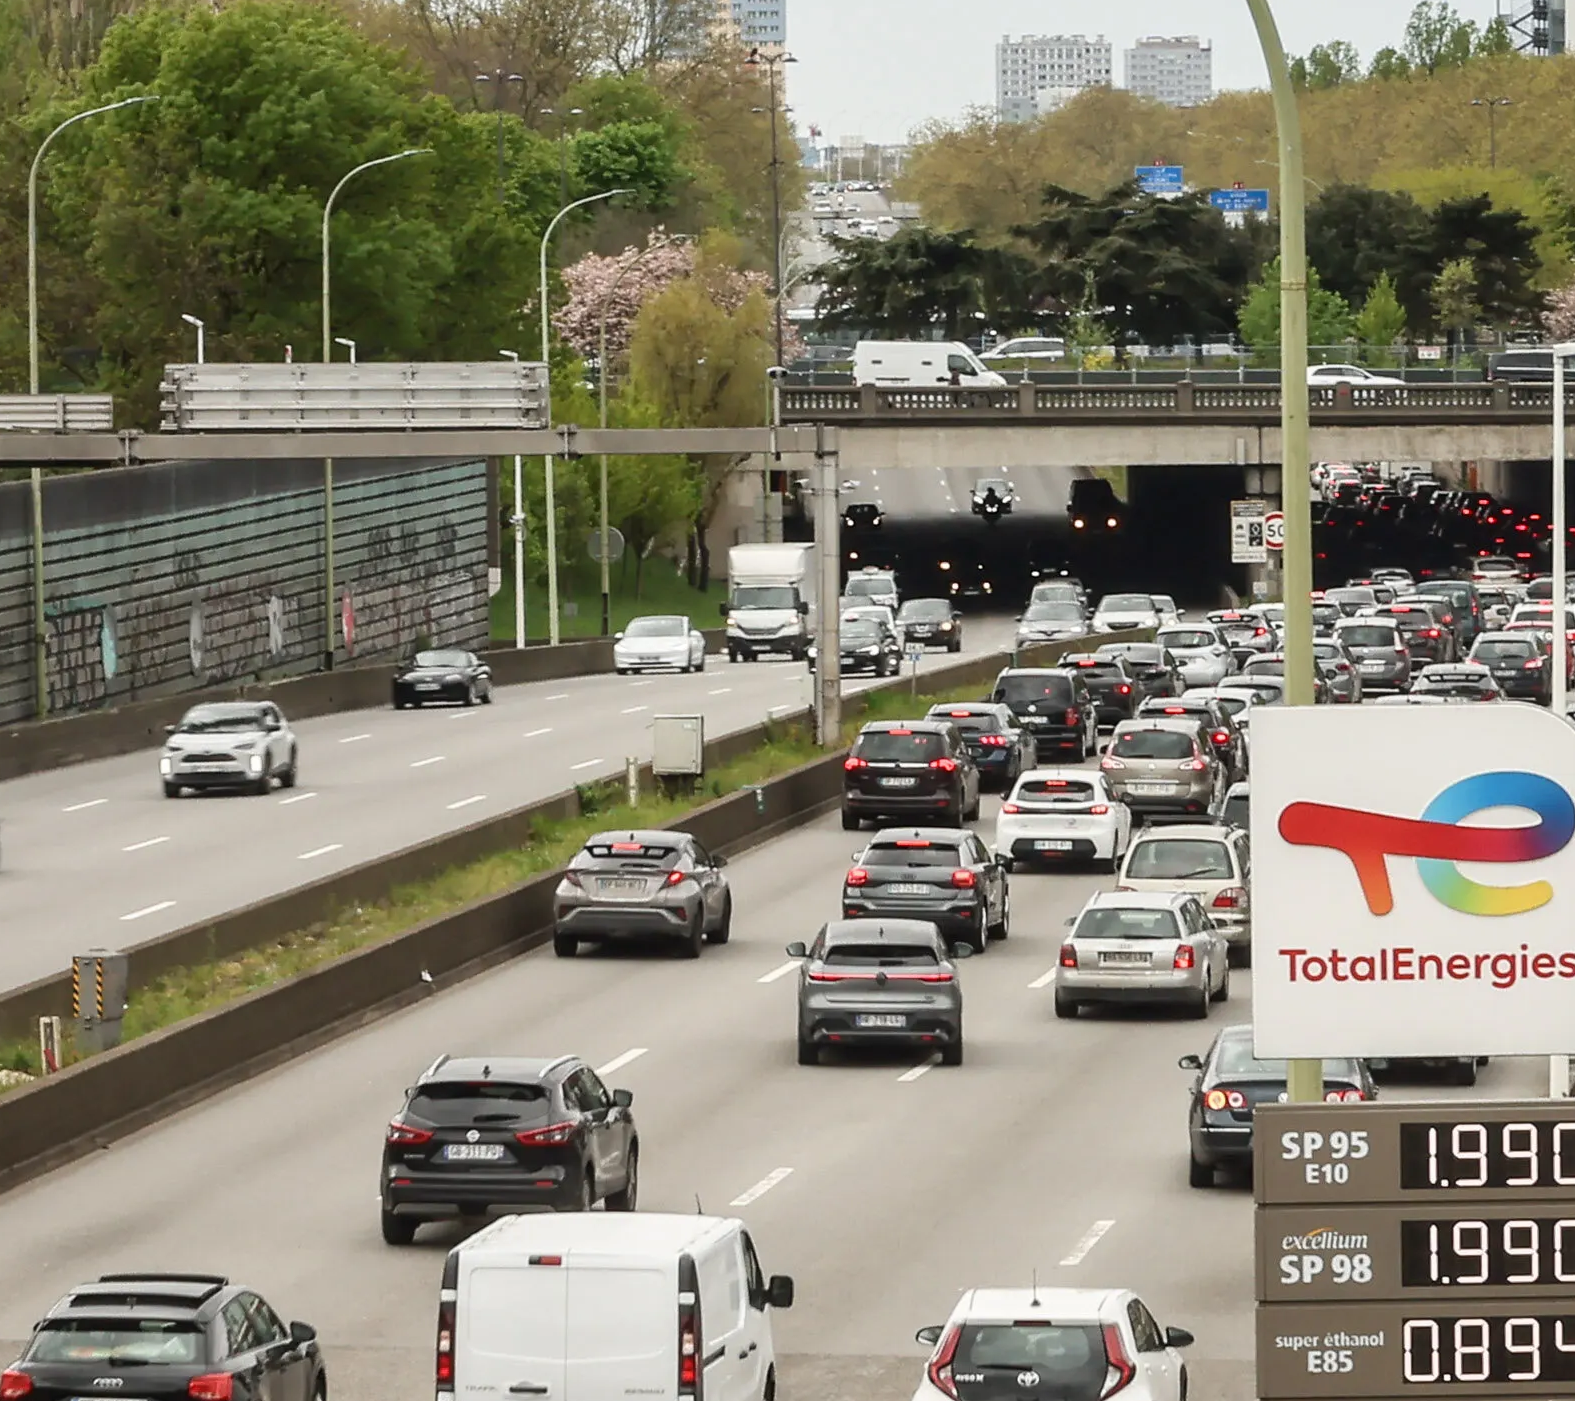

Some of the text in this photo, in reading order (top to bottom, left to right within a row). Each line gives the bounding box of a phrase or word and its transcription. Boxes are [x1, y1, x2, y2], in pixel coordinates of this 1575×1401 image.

[1268, 524, 1284, 538] 50
[1280, 1131, 1370, 1160] SP 95
[1305, 1163, 1350, 1185] E10
[1281, 1229, 1369, 1251] excellium
[1279, 1253, 1374, 1285] SP 98
[1275, 1331, 1385, 1350] super éthanol
[1306, 1350, 1354, 1374] E85
